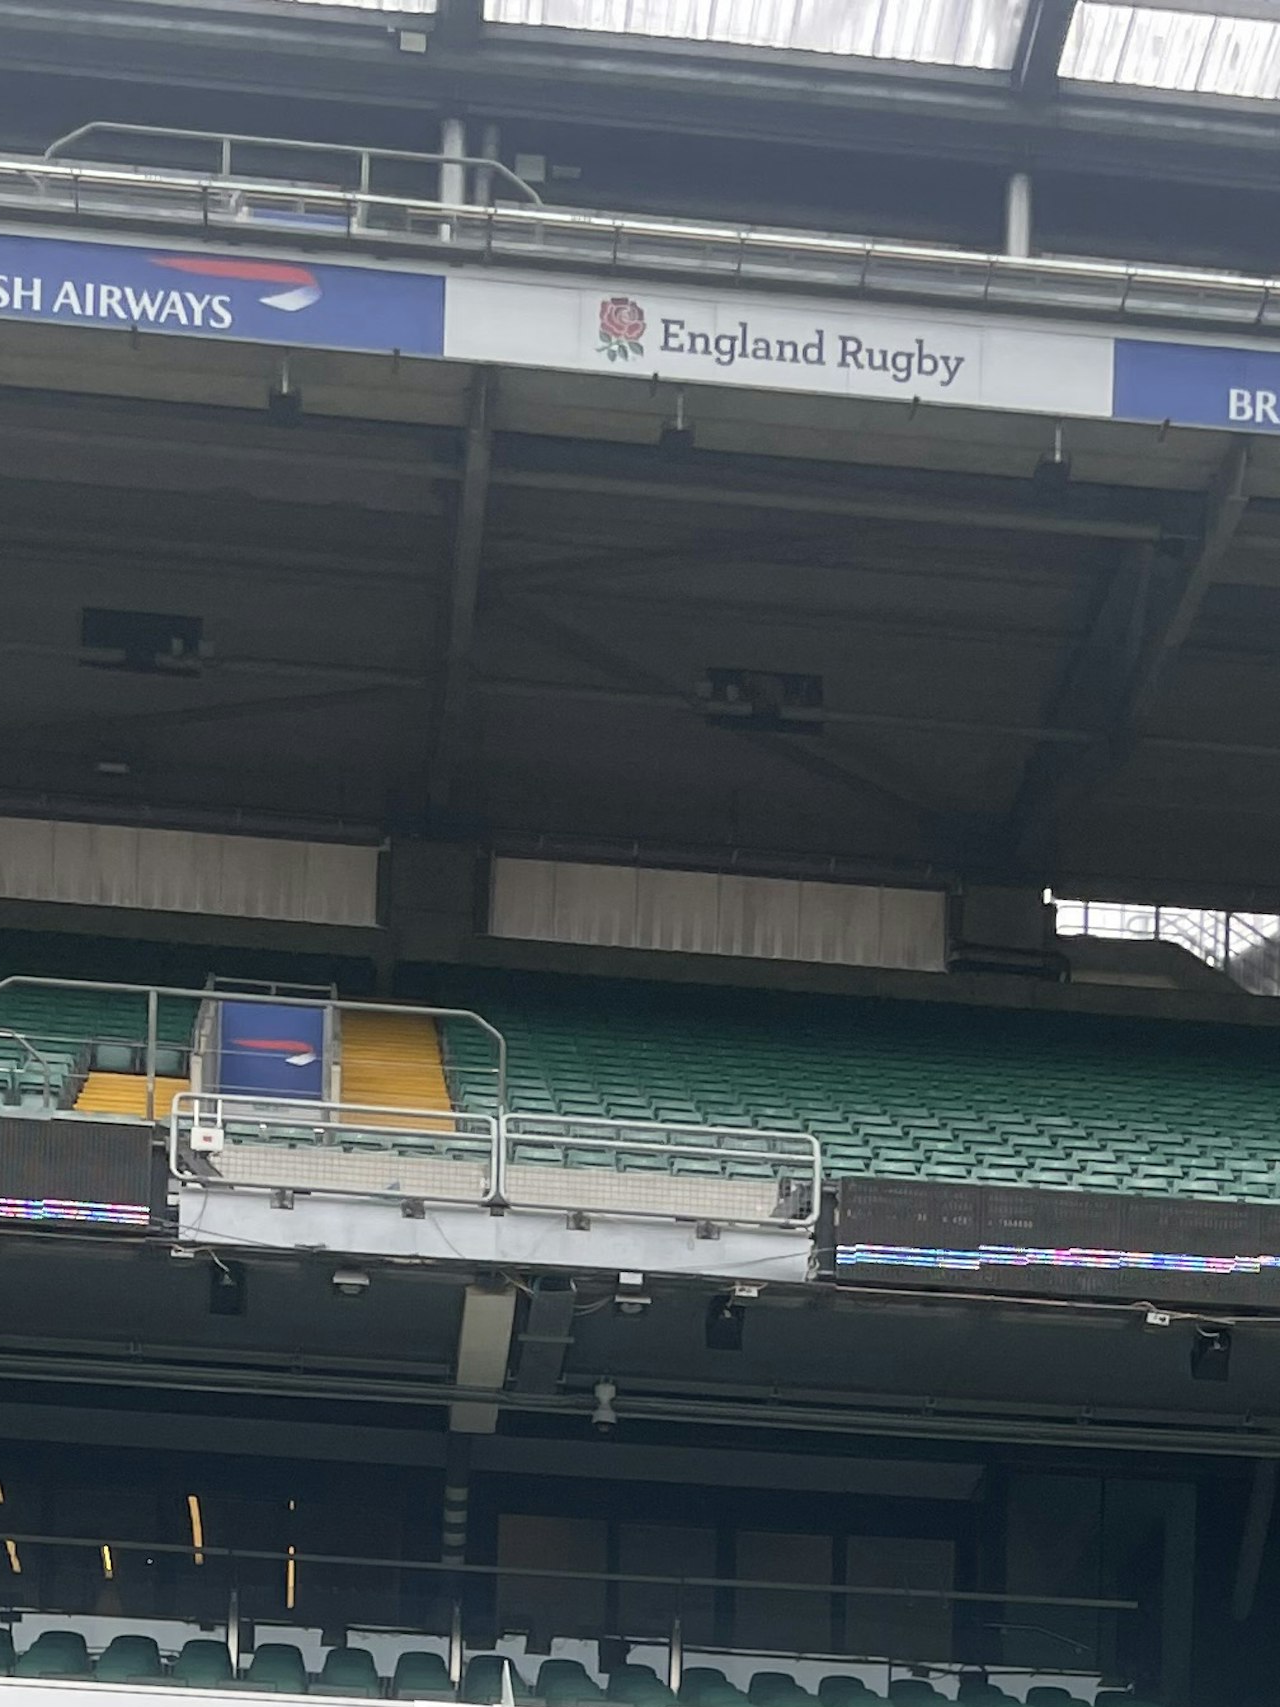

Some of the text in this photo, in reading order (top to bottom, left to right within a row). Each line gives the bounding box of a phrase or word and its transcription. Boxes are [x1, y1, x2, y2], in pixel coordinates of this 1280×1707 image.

[53, 280, 233, 330] AIRWAYS
[660, 318, 965, 387] England Rugby
